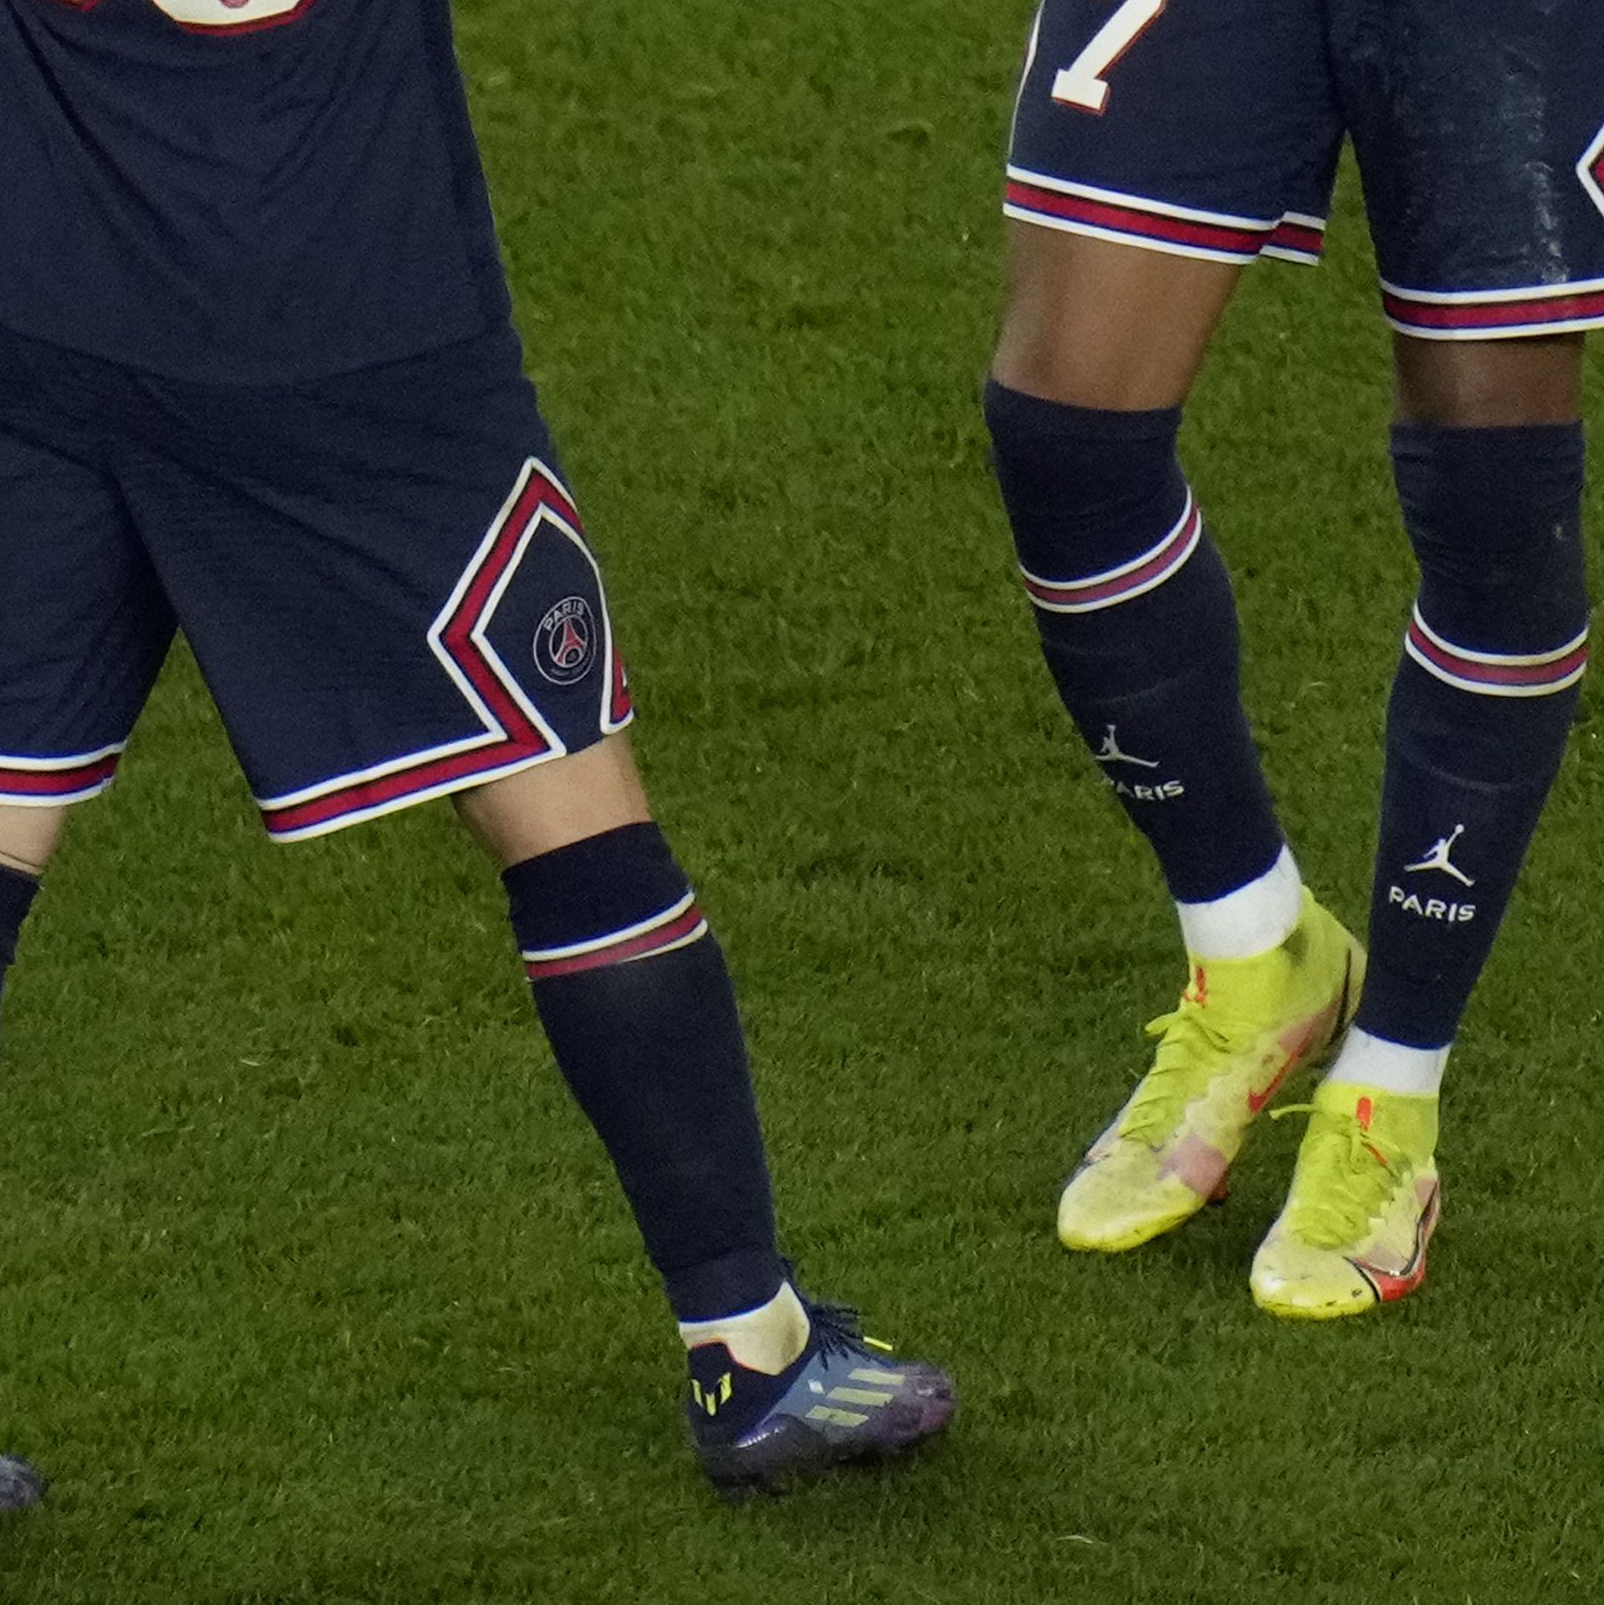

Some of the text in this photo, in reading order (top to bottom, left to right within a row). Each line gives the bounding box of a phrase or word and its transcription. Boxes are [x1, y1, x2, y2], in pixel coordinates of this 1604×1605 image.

[544, 600, 585, 631] PARIS
[1104, 778, 1184, 800] ARIS
[1389, 885, 1476, 922] PARIS
